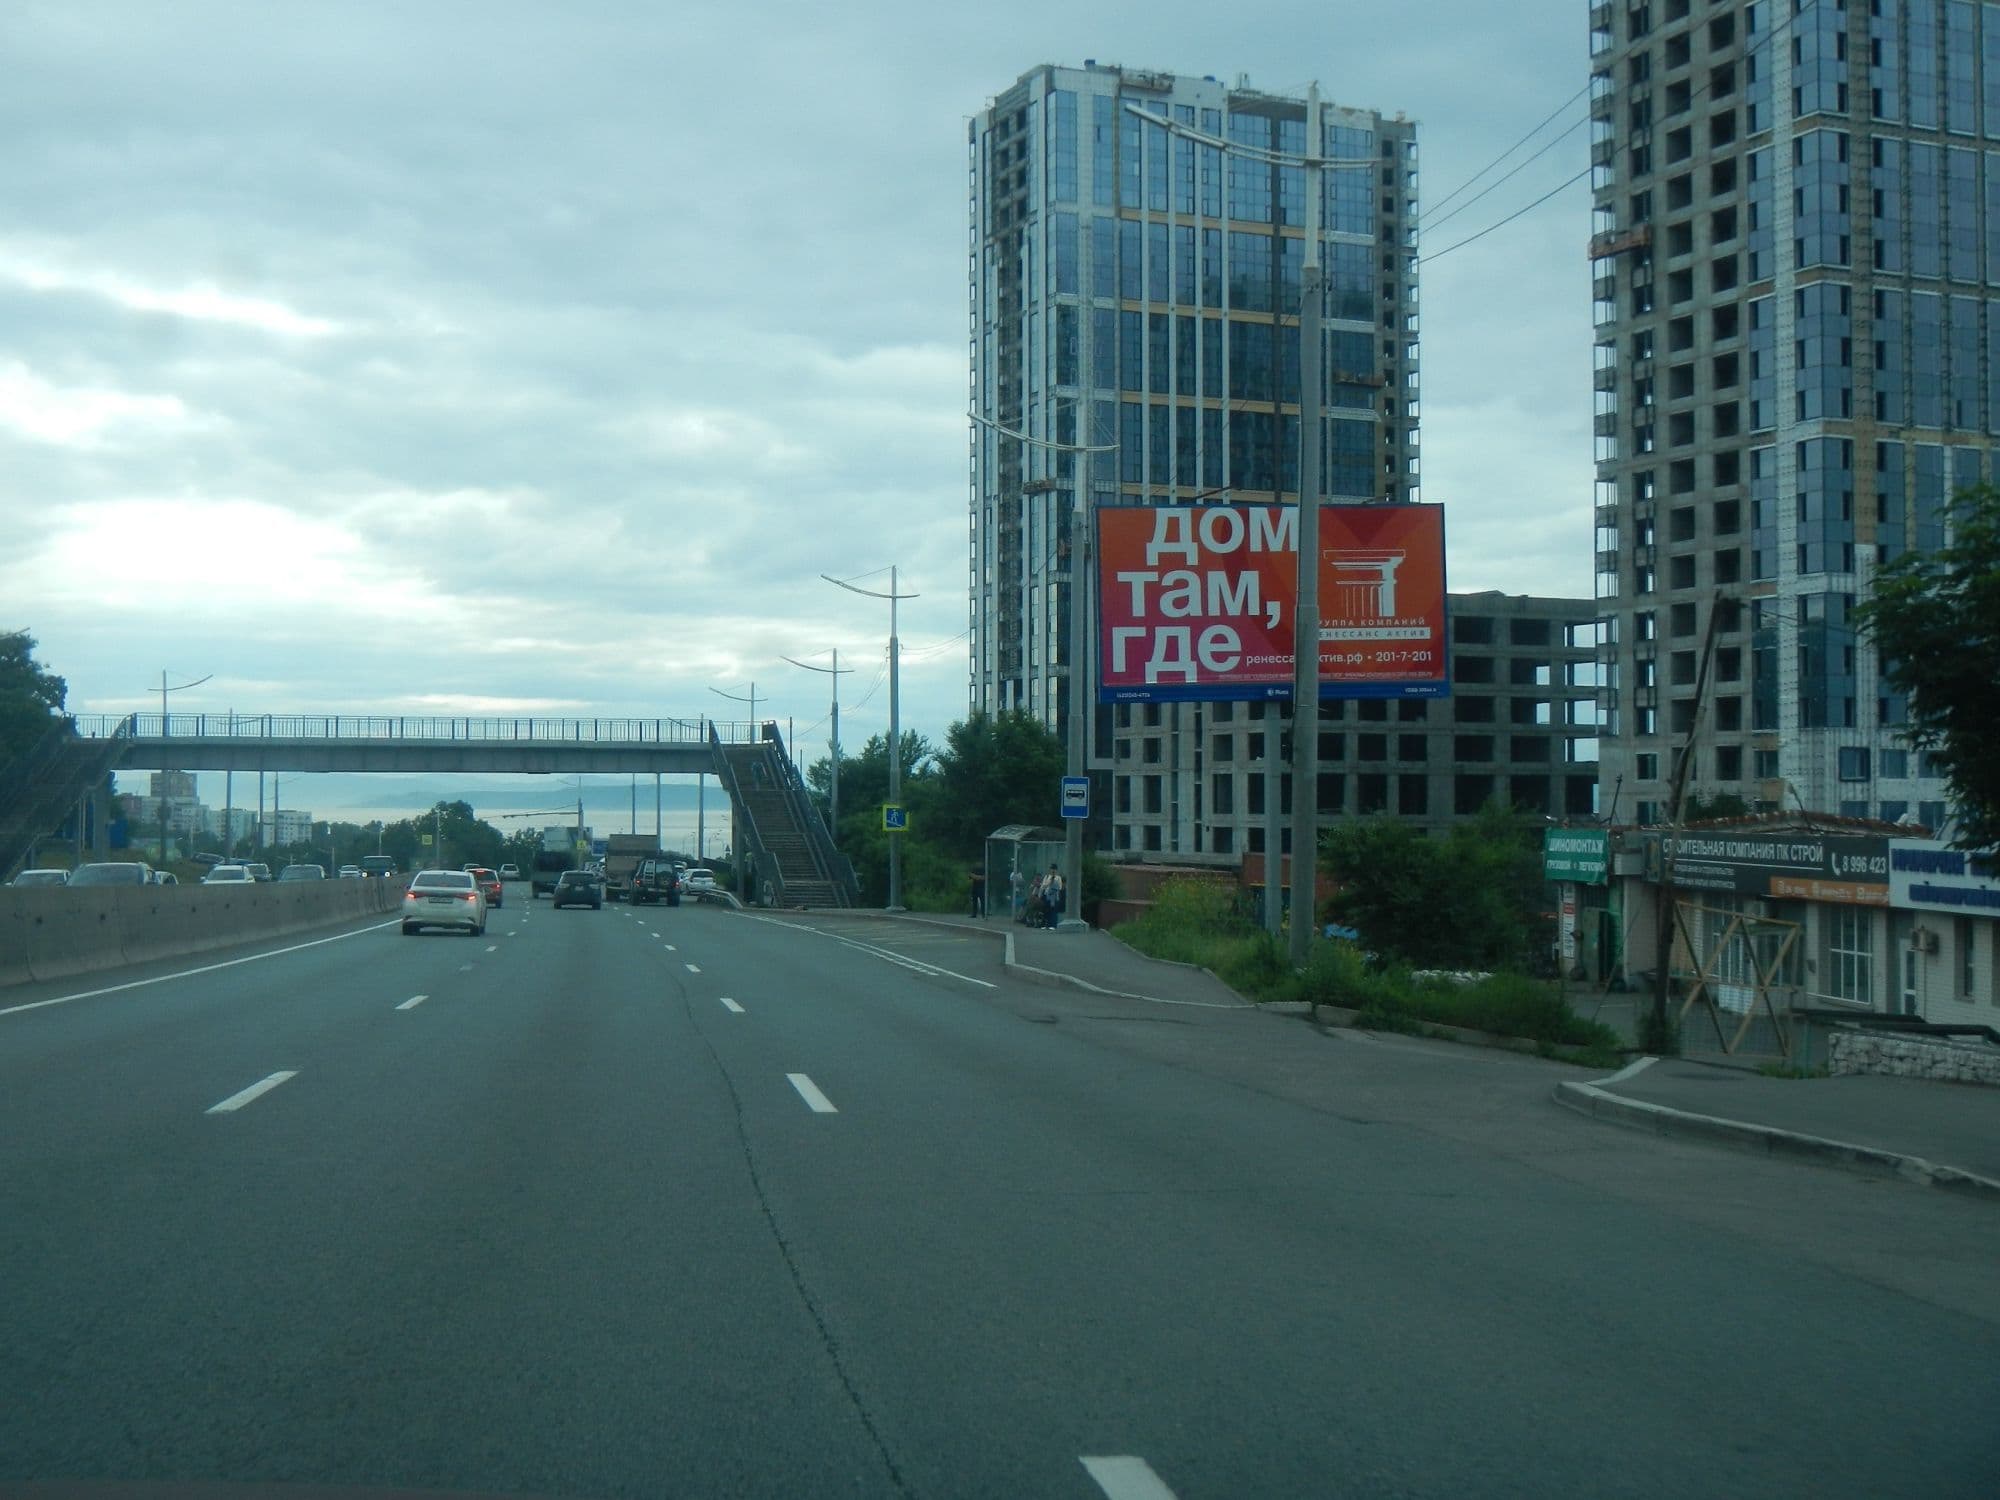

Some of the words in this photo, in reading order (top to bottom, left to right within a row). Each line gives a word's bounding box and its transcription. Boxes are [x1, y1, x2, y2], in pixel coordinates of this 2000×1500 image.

[1117, 569, 1280, 629] там,
[1360, 617, 1426, 627] КОМПАНИЙ
[1319, 630, 1379, 639] ЕНЕССАНС
[1387, 629, 1426, 638] АКТИВ
[1112, 624, 1242, 684] где
[1375, 651, 1432, 663] 201-7-201
[1662, 838, 1725, 856] СТОИТЕЛЬНАЯ
[1726, 841, 1775, 859] КОМПАНИЯ
[1790, 842, 1824, 863] СТРОЙ
[1842, 856, 1849, 873] 8
